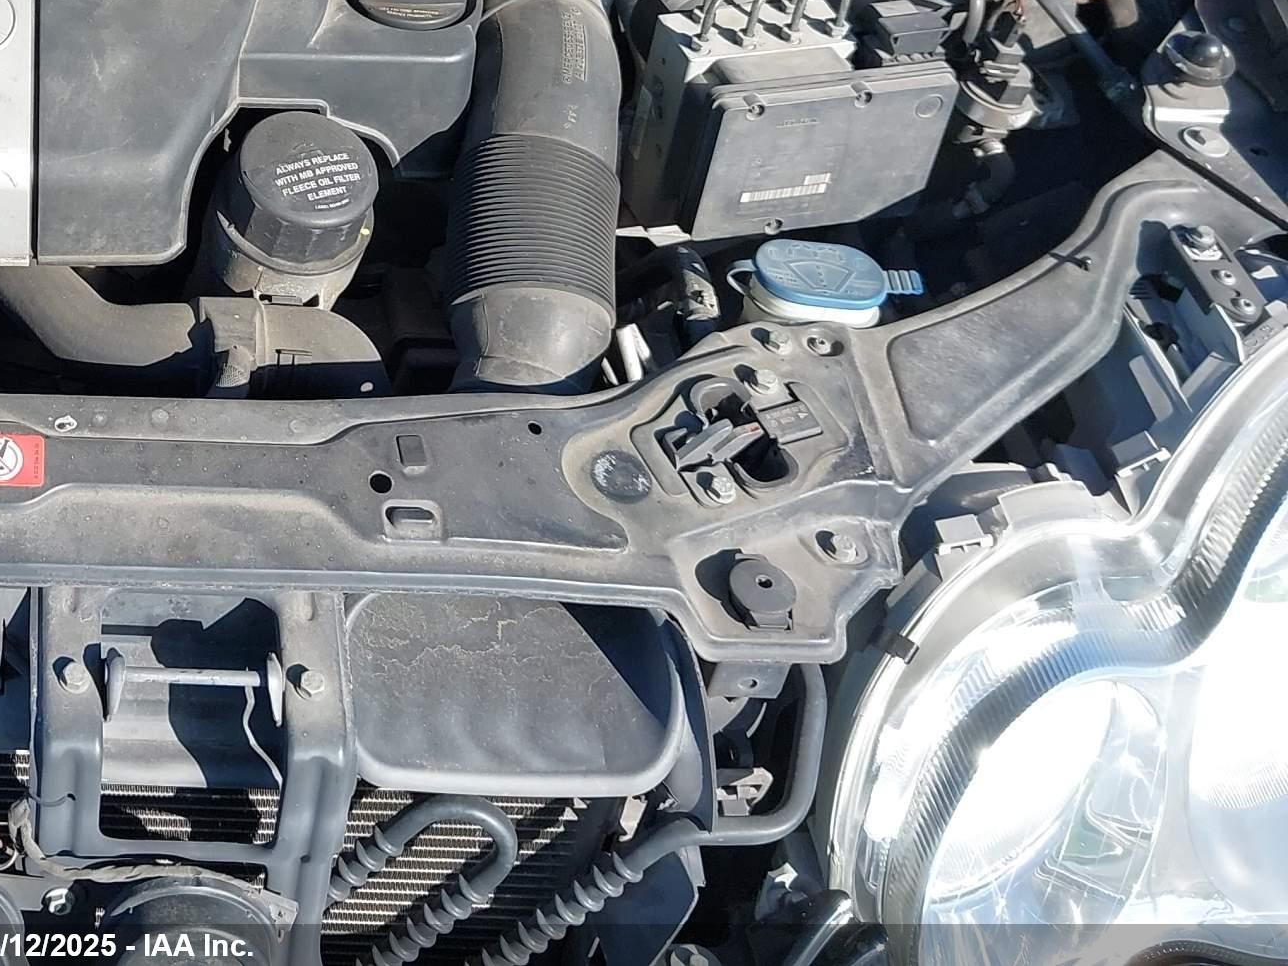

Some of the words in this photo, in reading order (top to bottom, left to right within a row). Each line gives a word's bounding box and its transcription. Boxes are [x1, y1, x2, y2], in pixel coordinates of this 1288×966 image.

[275, 174, 299, 187] WITH
[299, 170, 314, 180] MB
[315, 163, 358, 176] APPROVED
[276, 159, 312, 175] ALWAYS
[312, 153, 350, 165] REPLACE
[282, 180, 318, 197] FLEECE
[318, 177, 333, 186] OIL
[334, 173, 361, 184] FILTER
[307, 186, 348, 201] ELEMENT
